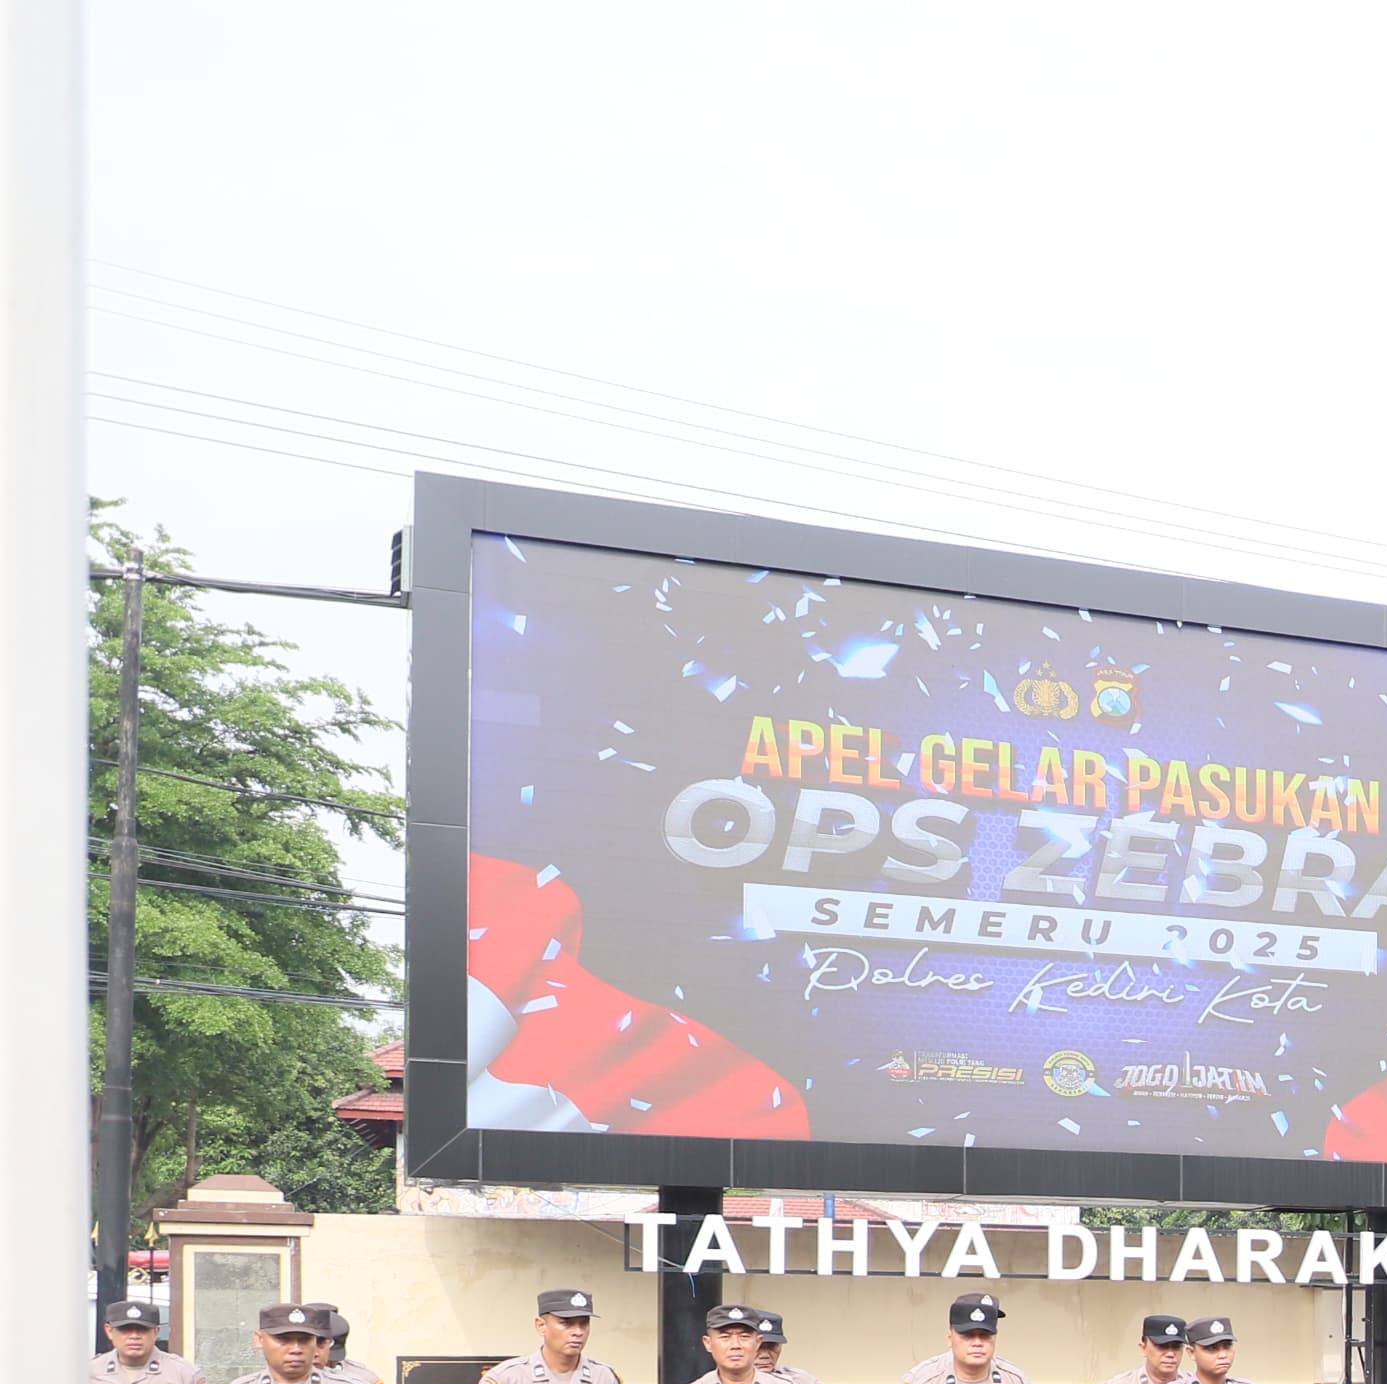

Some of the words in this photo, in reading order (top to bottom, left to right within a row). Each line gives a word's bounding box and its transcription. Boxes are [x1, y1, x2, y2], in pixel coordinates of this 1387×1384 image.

[740, 715, 902, 788] APEL
[919, 732, 1107, 808] GELAR
[1127, 757, 1381, 835] PASUKAN
[663, 778, 971, 885] OPS
[811, 897, 1112, 946] SEMERU
[1162, 924, 1321, 961] 2025
[803, 946, 994, 1000] Polres
[1008, 960, 1185, 1013] Kediri
[1198, 973, 1329, 1024] Kota
[918, 1063, 1025, 1081] PRESISI
[624, 1212, 1001, 1278] TATHYA
